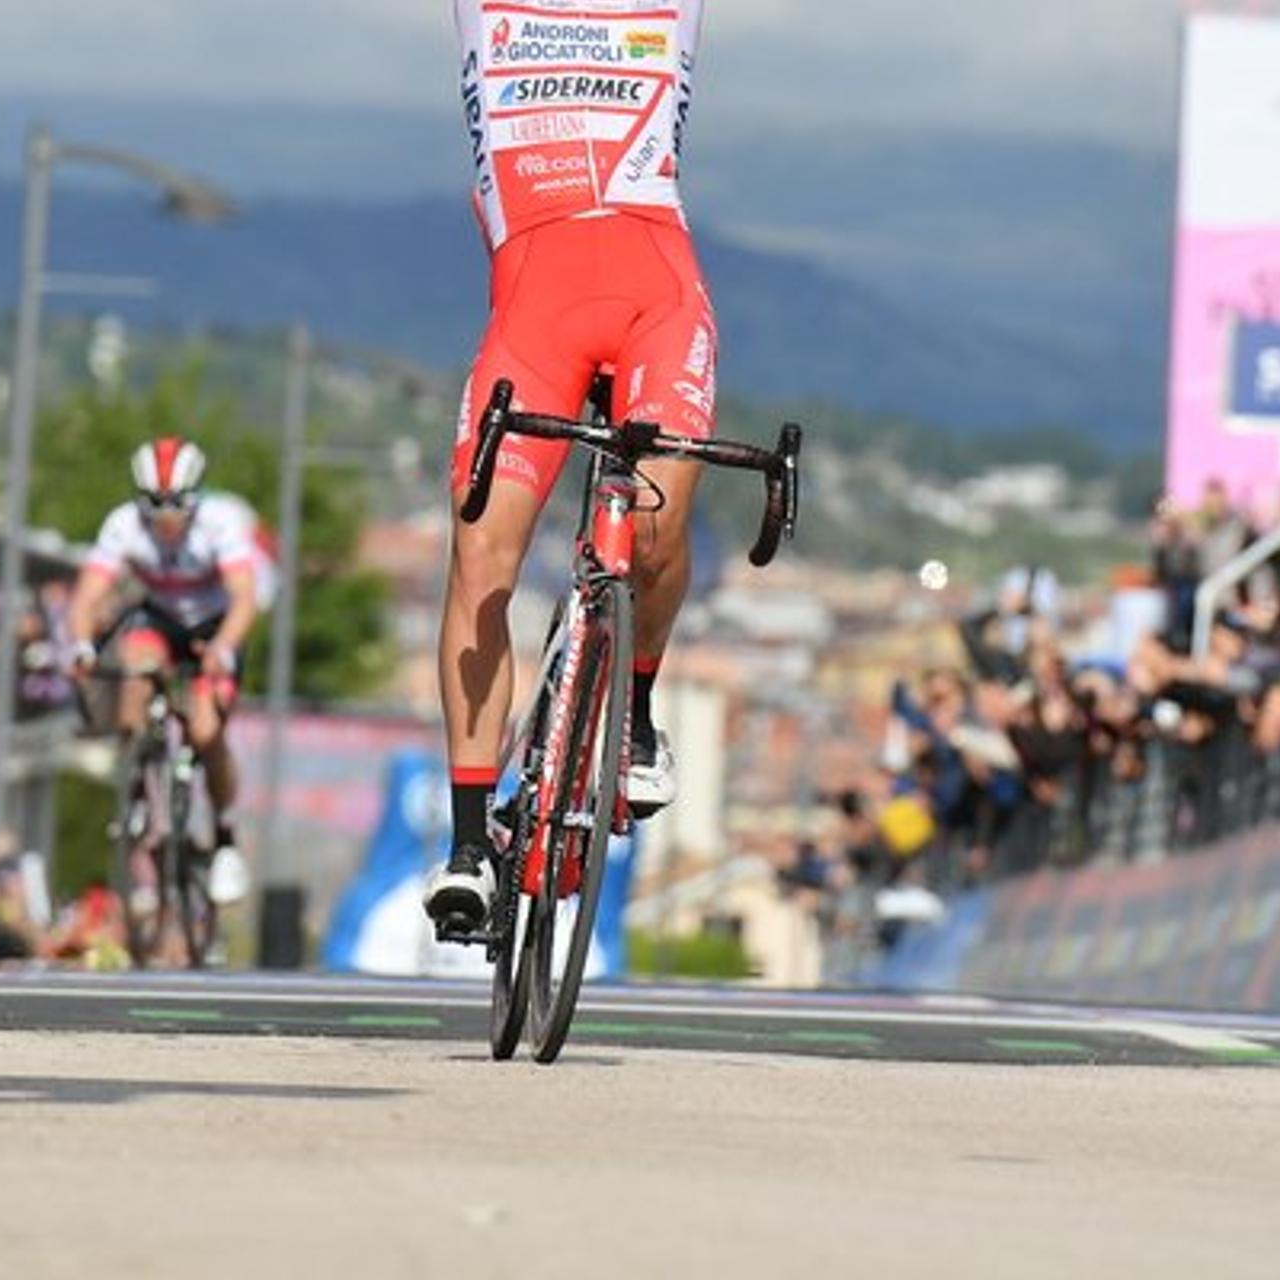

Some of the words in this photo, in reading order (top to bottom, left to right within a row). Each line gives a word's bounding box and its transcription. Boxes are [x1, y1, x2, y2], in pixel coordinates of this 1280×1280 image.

[521, 22, 609, 40] ANDRONI
[508, 41, 623, 61] GIOCATTOLI
[517, 77, 644, 100] SIDERMEC
